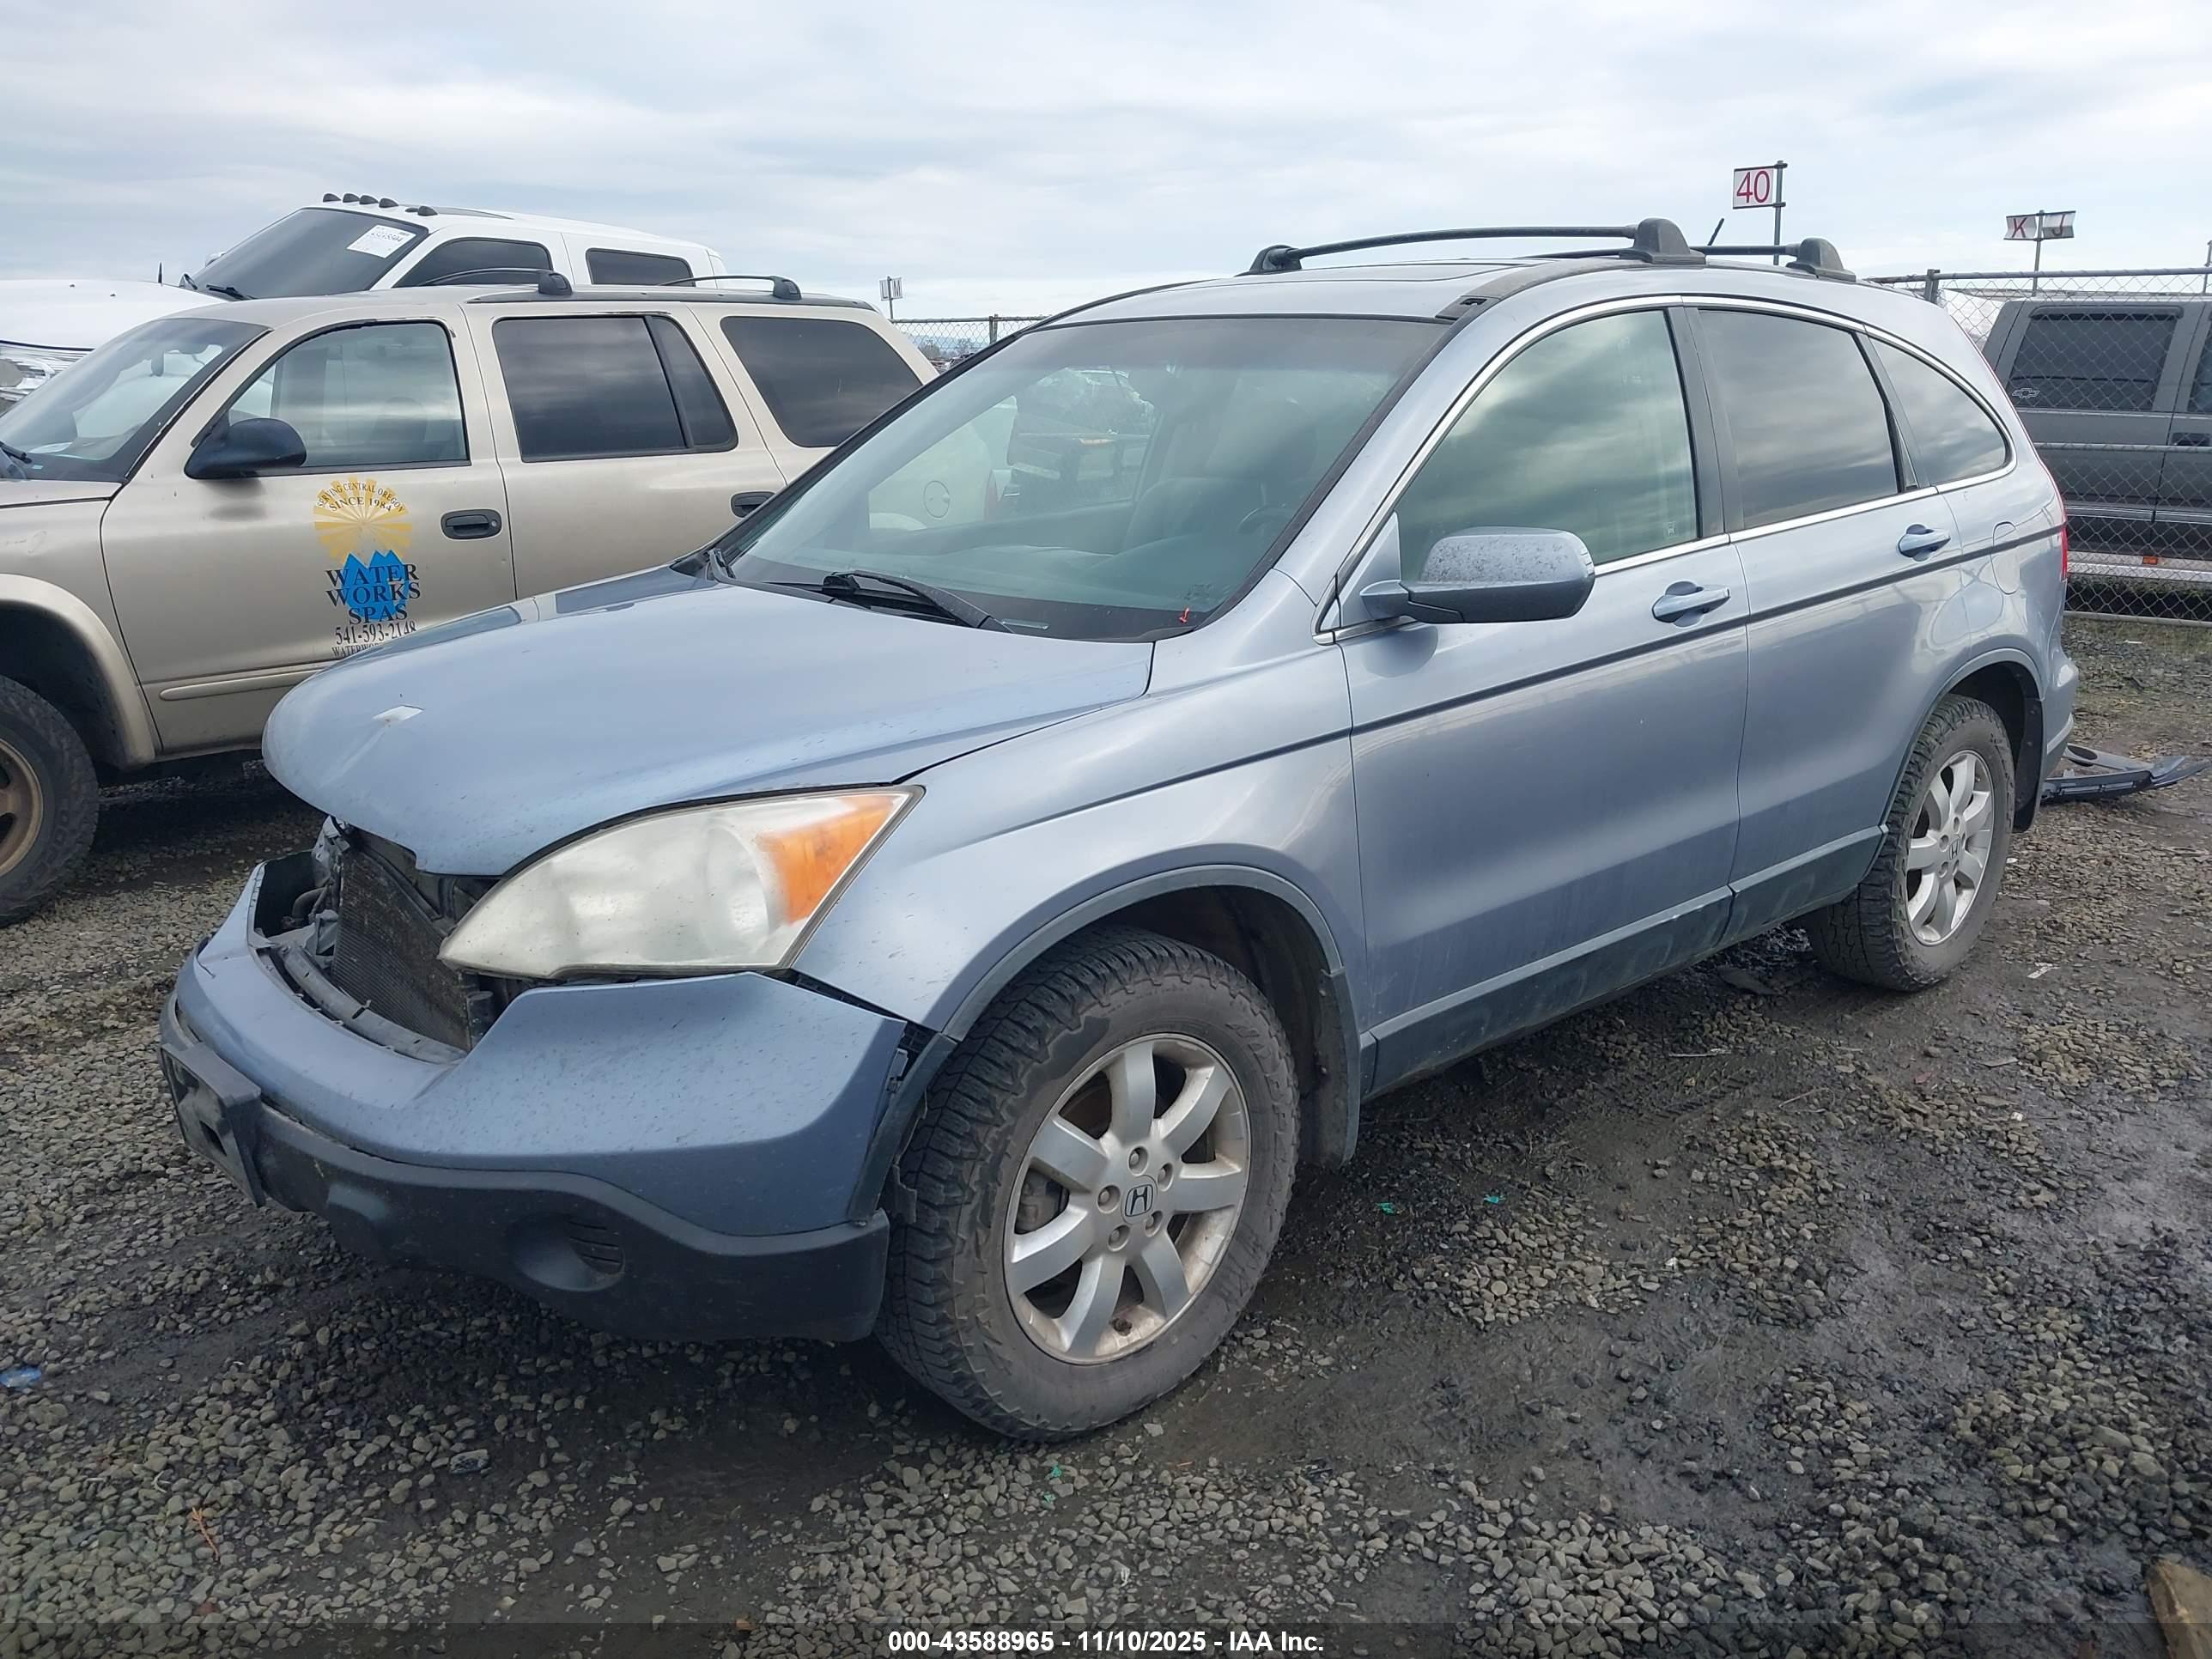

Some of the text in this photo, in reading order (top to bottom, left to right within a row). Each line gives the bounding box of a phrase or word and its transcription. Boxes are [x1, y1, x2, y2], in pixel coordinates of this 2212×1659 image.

[1736, 170, 1771, 204] 40
[2051, 213, 2065, 236] J
[317, 482, 405, 513] SERVING CENTRAL OREGON
[330, 496, 392, 512] SINCE 1984
[325, 563, 419, 586] WATER
[325, 582, 421, 607] WORKS
[348, 603, 408, 625] SPAS
